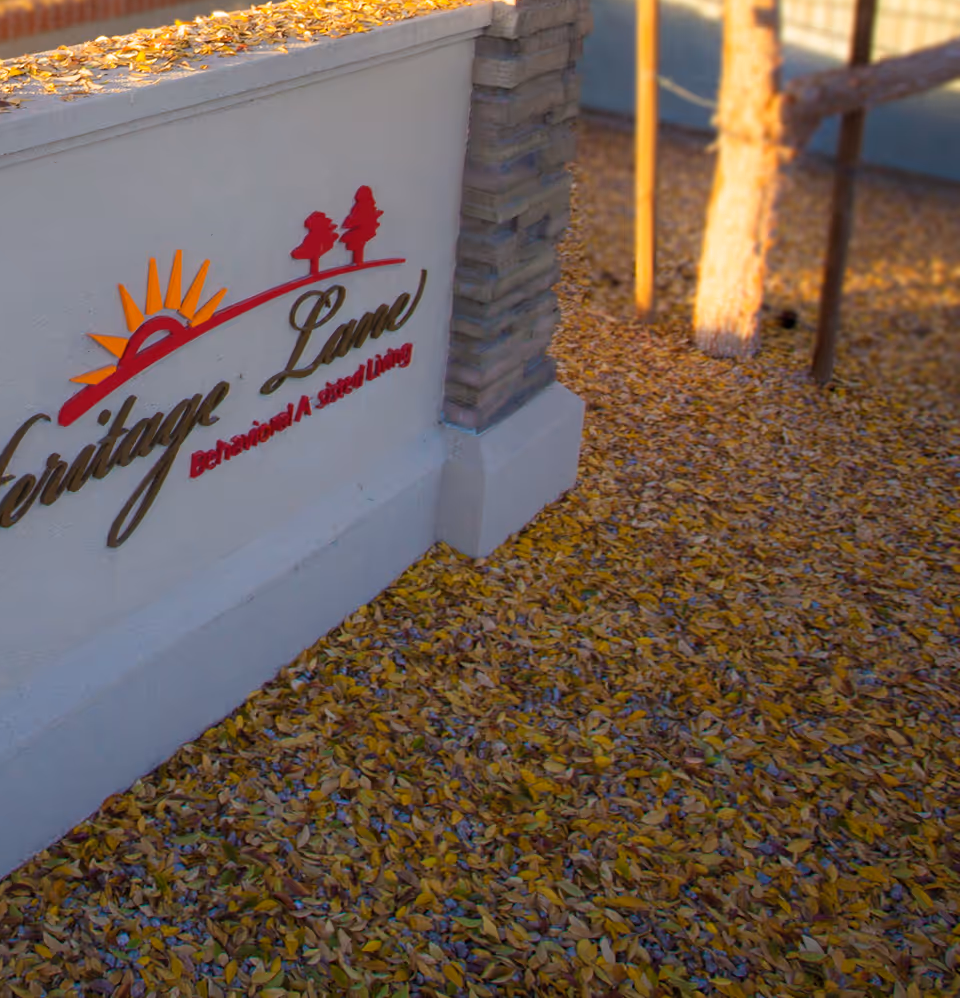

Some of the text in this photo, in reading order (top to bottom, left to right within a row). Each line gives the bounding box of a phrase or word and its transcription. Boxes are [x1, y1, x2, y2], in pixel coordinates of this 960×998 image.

[260, 269, 428, 395] Lane
[189, 403, 294, 479] Behavioral
[366, 342, 413, 381] Living
